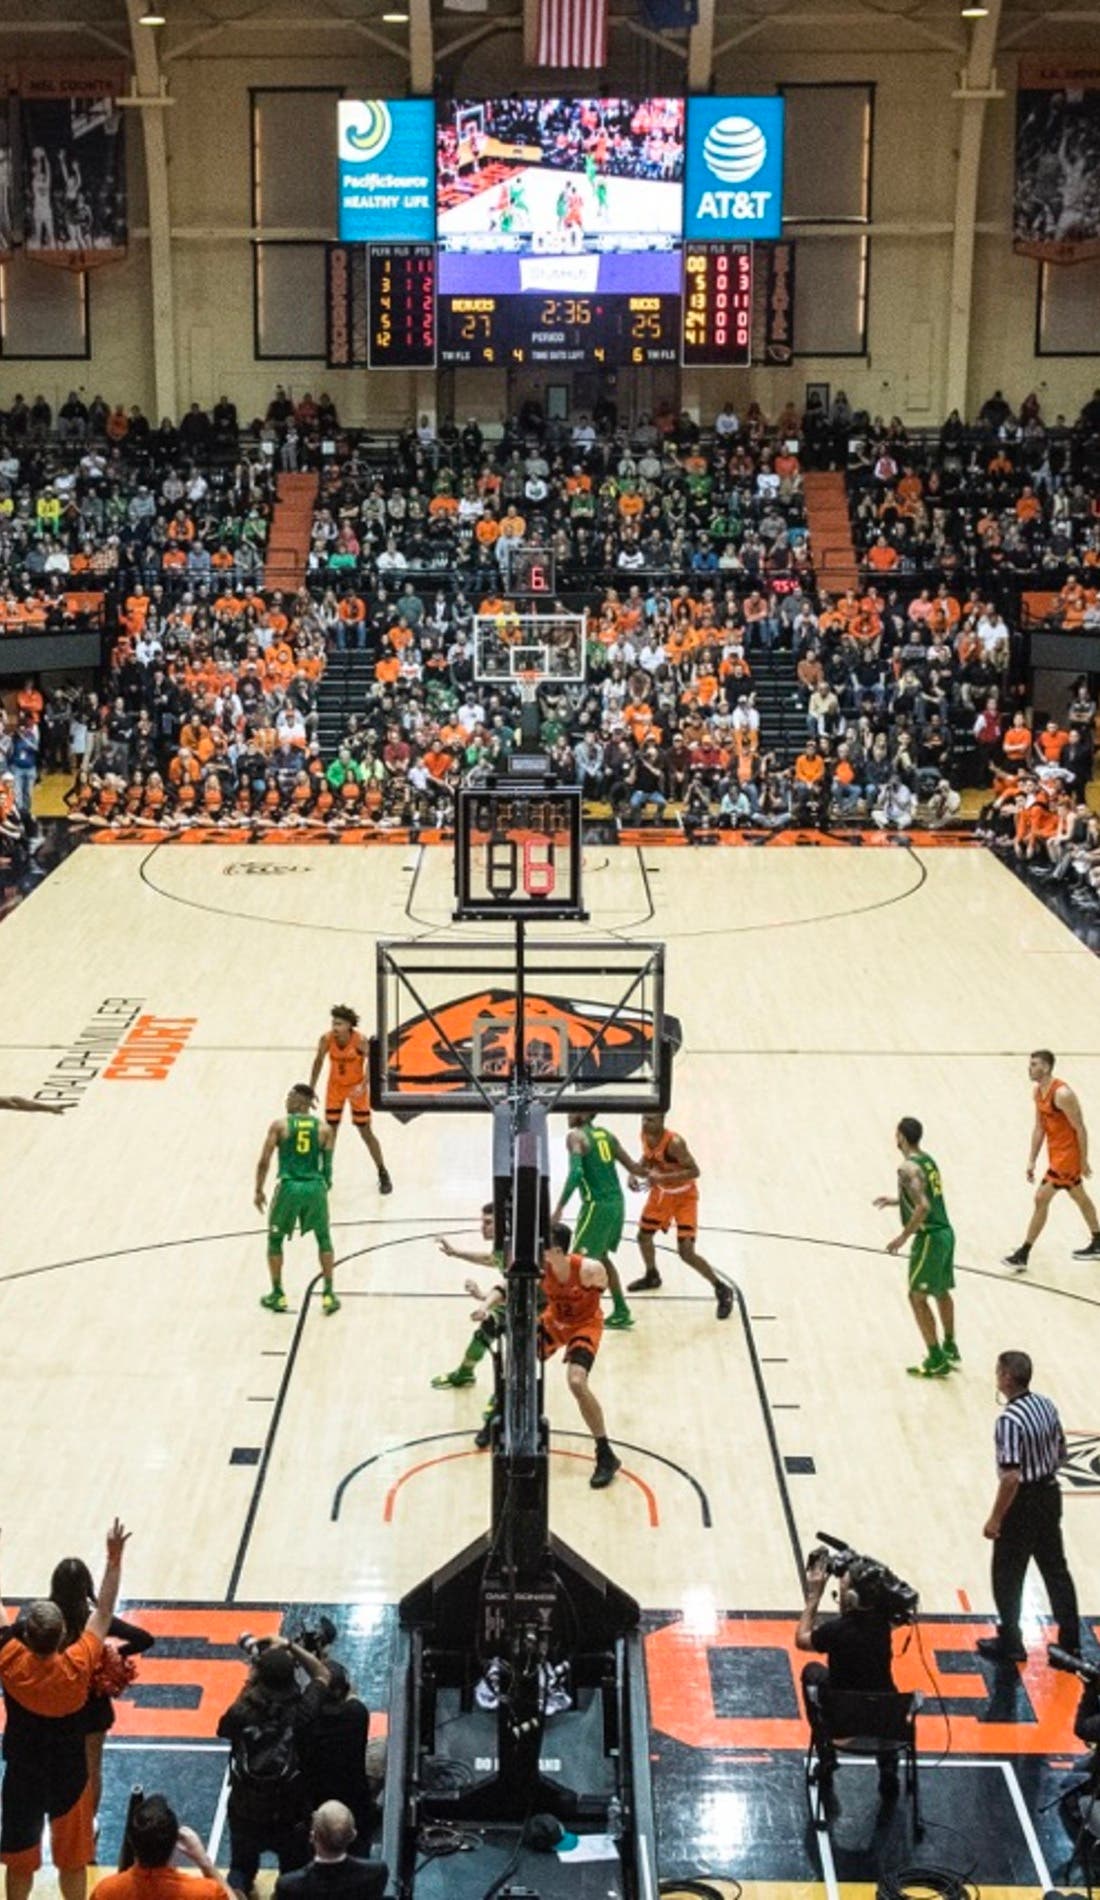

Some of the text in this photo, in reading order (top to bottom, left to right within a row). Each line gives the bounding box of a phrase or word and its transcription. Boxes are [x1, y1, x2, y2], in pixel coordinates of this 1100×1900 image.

[343, 174, 428, 191] PacificSource
[343, 196, 430, 208] HEALTHY LIFE
[696, 192, 772, 218] AT&T
[385, 260, 434, 273] 1 1 11
[687, 256, 749, 273] 00 0 5
[381, 278, 432, 292] 3 1 2
[696, 274, 749, 290] 5 0 3
[381, 296, 432, 310] 4 1 2
[451, 299, 495, 312] BEAVERS
[717, 293, 727, 309] 0
[734, 294, 749, 308] 11
[541, 300, 591, 325] 2:36
[716, 311, 726, 327] 0
[738, 311, 748, 327] 0
[381, 314, 432, 329] 5 1 2
[461, 315, 491, 339] 27
[632, 314, 661, 338] 25
[377, 331, 432, 347] 12 1 5
[532, 332, 565, 343] PERIOD
[686, 329, 748, 345] 41 0 0
[513, 348, 523, 362] 4
[594, 348, 604, 362] 4
[632, 347, 643, 362] 6
[531, 567, 545, 589] 6
[524, 838, 554, 894] 6
[33, 998, 147, 1101] RALPH MILLER
[102, 1015, 197, 1080] COURT
[296, 1130, 310, 1152] 5
[597, 1139, 611, 1162] 0
